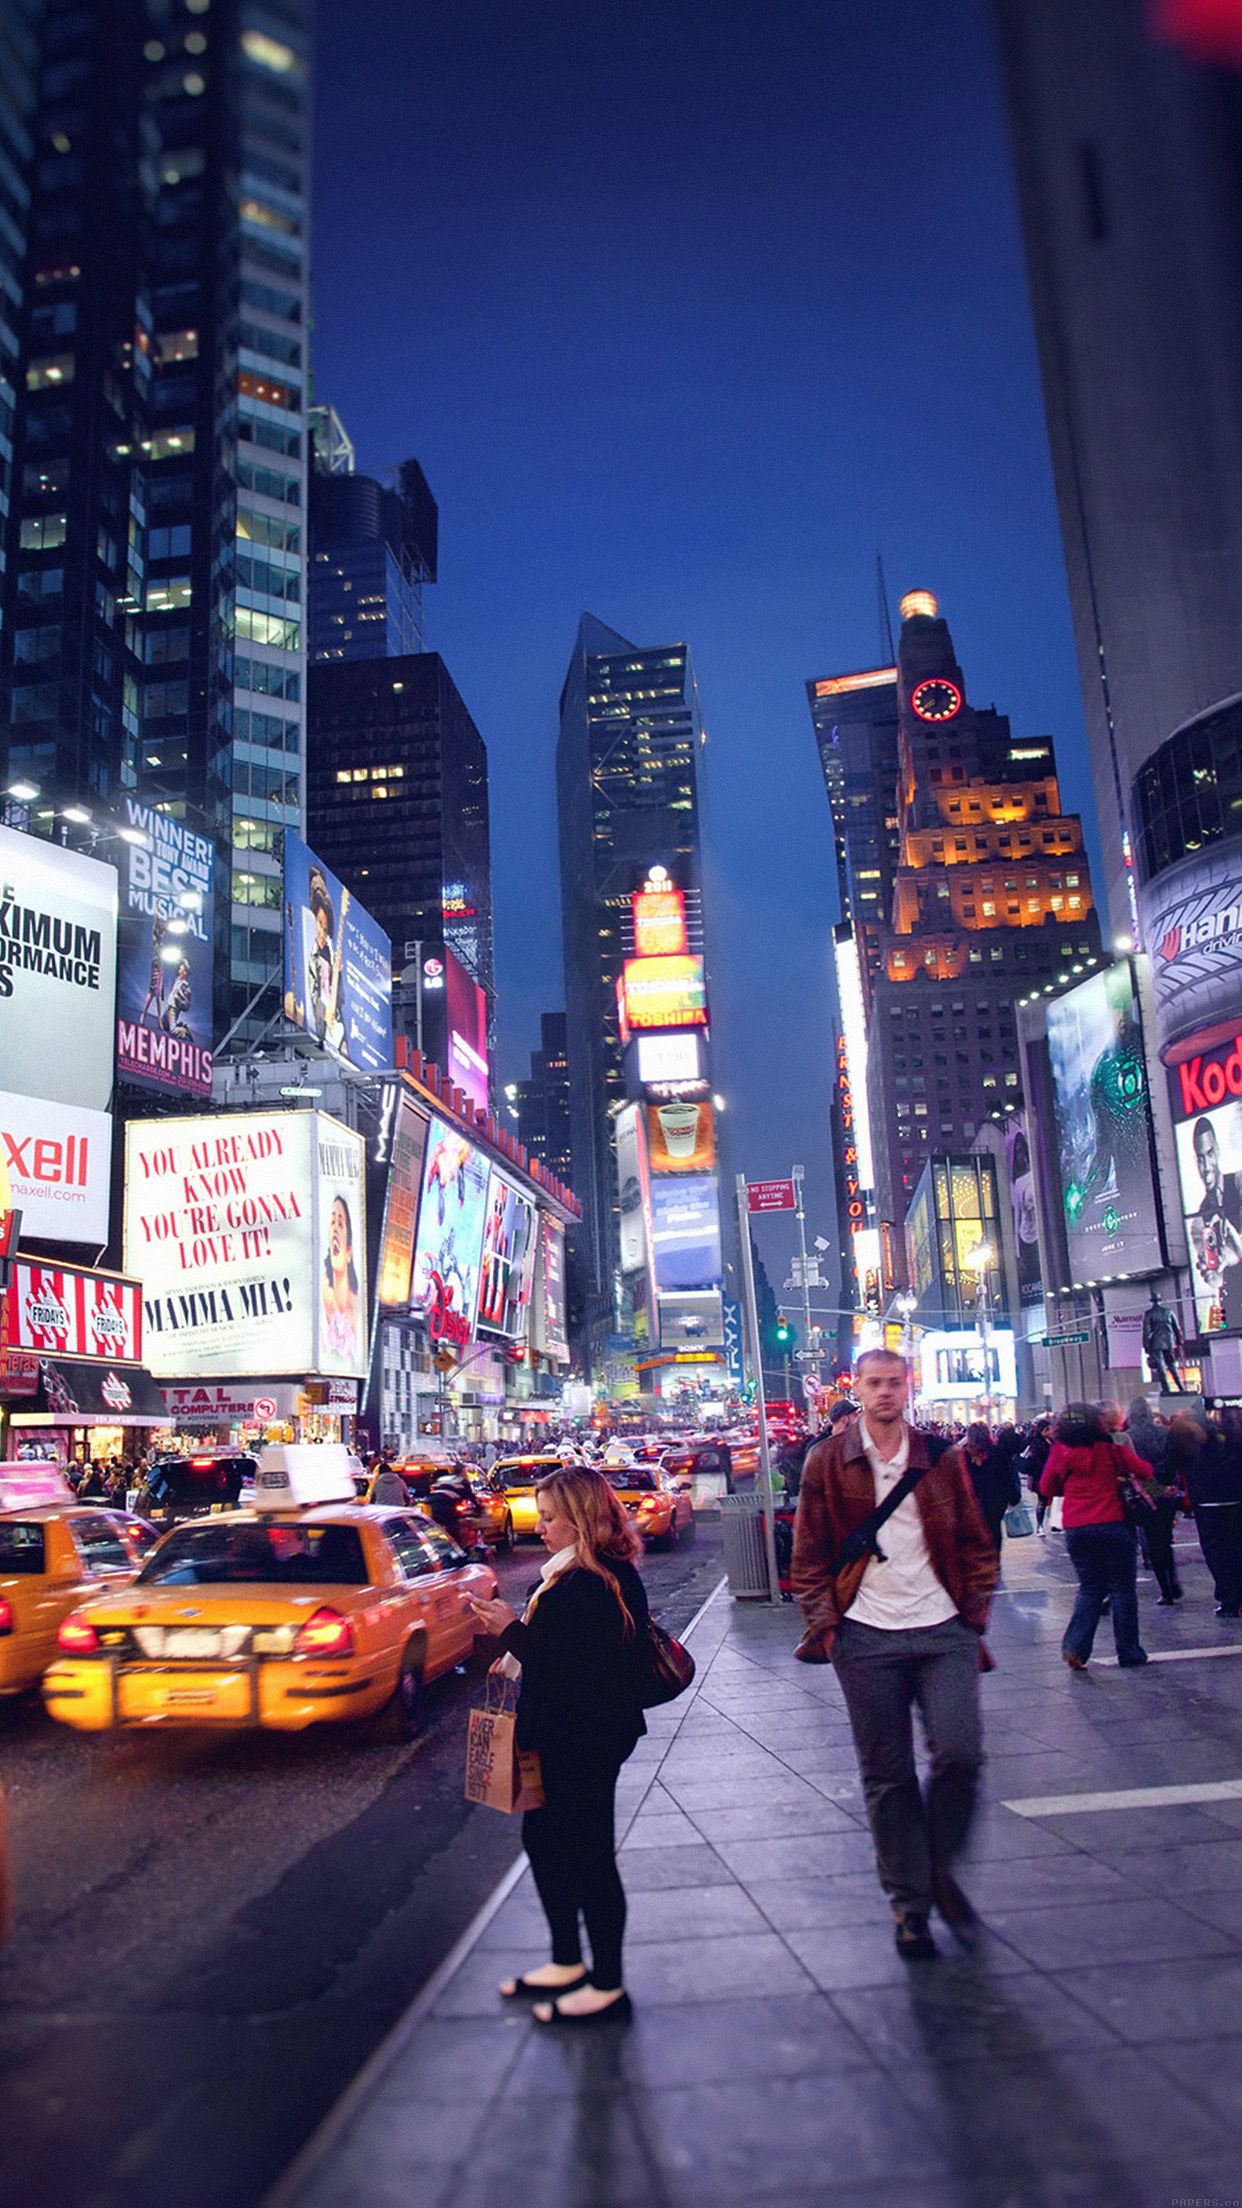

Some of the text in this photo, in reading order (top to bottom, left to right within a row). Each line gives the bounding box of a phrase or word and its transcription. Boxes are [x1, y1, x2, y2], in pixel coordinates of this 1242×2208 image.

[126, 799, 213, 866] WINNER!
[129, 845, 209, 916] BEST
[128, 889, 208, 941] MUSICAL
[629, 1009, 707, 1027] TOSHIBA
[118, 1018, 213, 1084] MEMPHIS
[837, 1035, 852, 1128] ERNST
[845, 1147, 857, 1162] &
[139, 1127, 284, 1178] YOU ALREADY
[184, 1166, 248, 1203] KNOW
[758, 1192, 784, 1200] ANYTIME
[761, 1183, 790, 1192] STOPPING
[140, 1191, 301, 1242] YOU'RE GONNA
[179, 1227, 271, 1269] LOVE IT!
[32, 1306, 65, 1325] FRIDAYS
[97, 1316, 124, 1334] FRIDAYS
[144, 1289, 234, 1334] MAMMA
[239, 1277, 293, 1320] MIA!
[1049, 1335, 1083, 1346] Broadway
